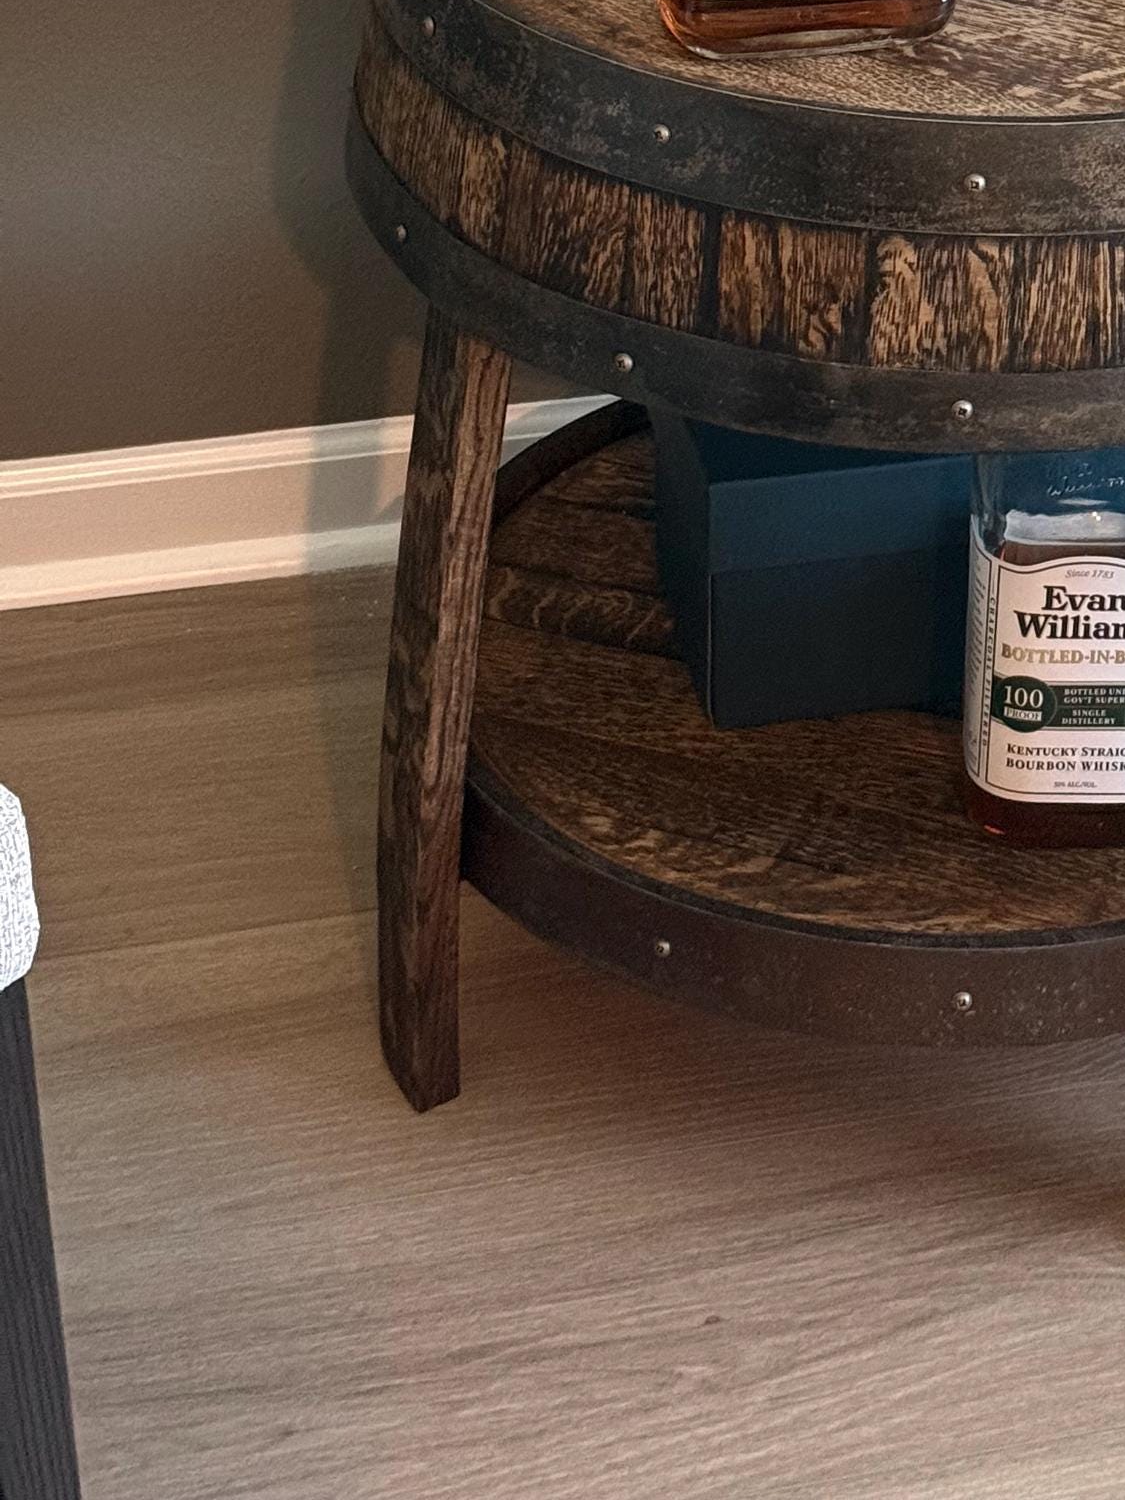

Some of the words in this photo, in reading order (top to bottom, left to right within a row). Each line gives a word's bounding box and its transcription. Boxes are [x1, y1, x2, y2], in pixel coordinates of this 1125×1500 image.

[1065, 569, 1090, 578] Since
[1004, 685, 1044, 708] 100
[1064, 688, 1107, 696] BOTTLED
[1005, 707, 1041, 721] PROOF
[1061, 717, 1117, 725] DISTILLERY
[1007, 743, 1077, 757] KENTUCKY
[1006, 757, 1077, 771] BOURBON
